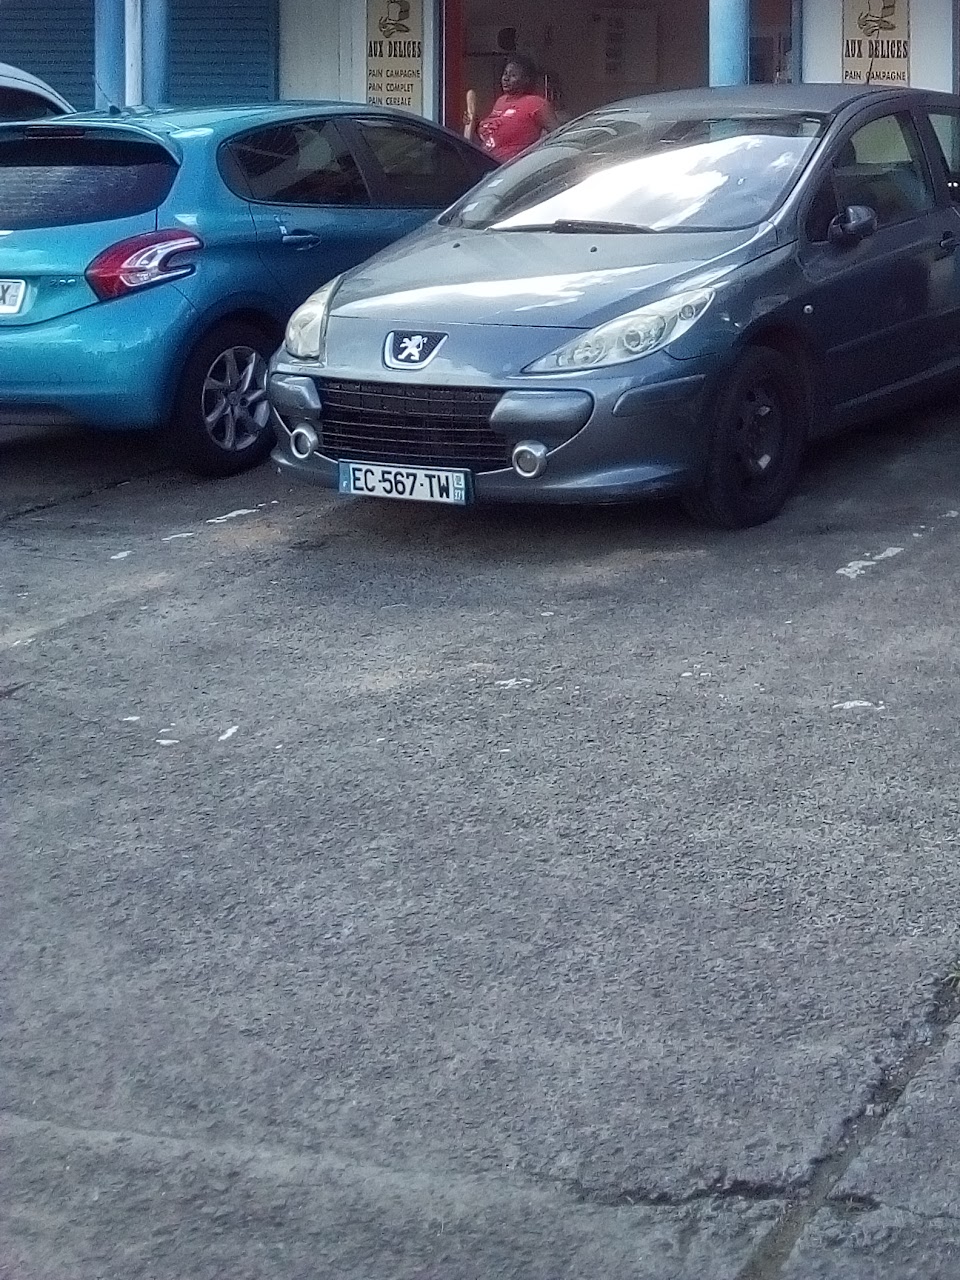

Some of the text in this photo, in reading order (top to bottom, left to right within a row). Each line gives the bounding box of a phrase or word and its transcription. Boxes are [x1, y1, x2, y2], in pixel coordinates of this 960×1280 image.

[368, 40, 422, 58] AUX DELICES
[845, 39, 909, 59] AUX DELICES
[368, 69, 421, 79] PAIN CAMPAGNE
[844, 70, 906, 81] PAIN CAMPAGNE
[368, 83, 414, 93] PAIN COMPLET
[368, 97, 383, 106] PAIN
[352, 467, 450, 499] EC-567-TW
